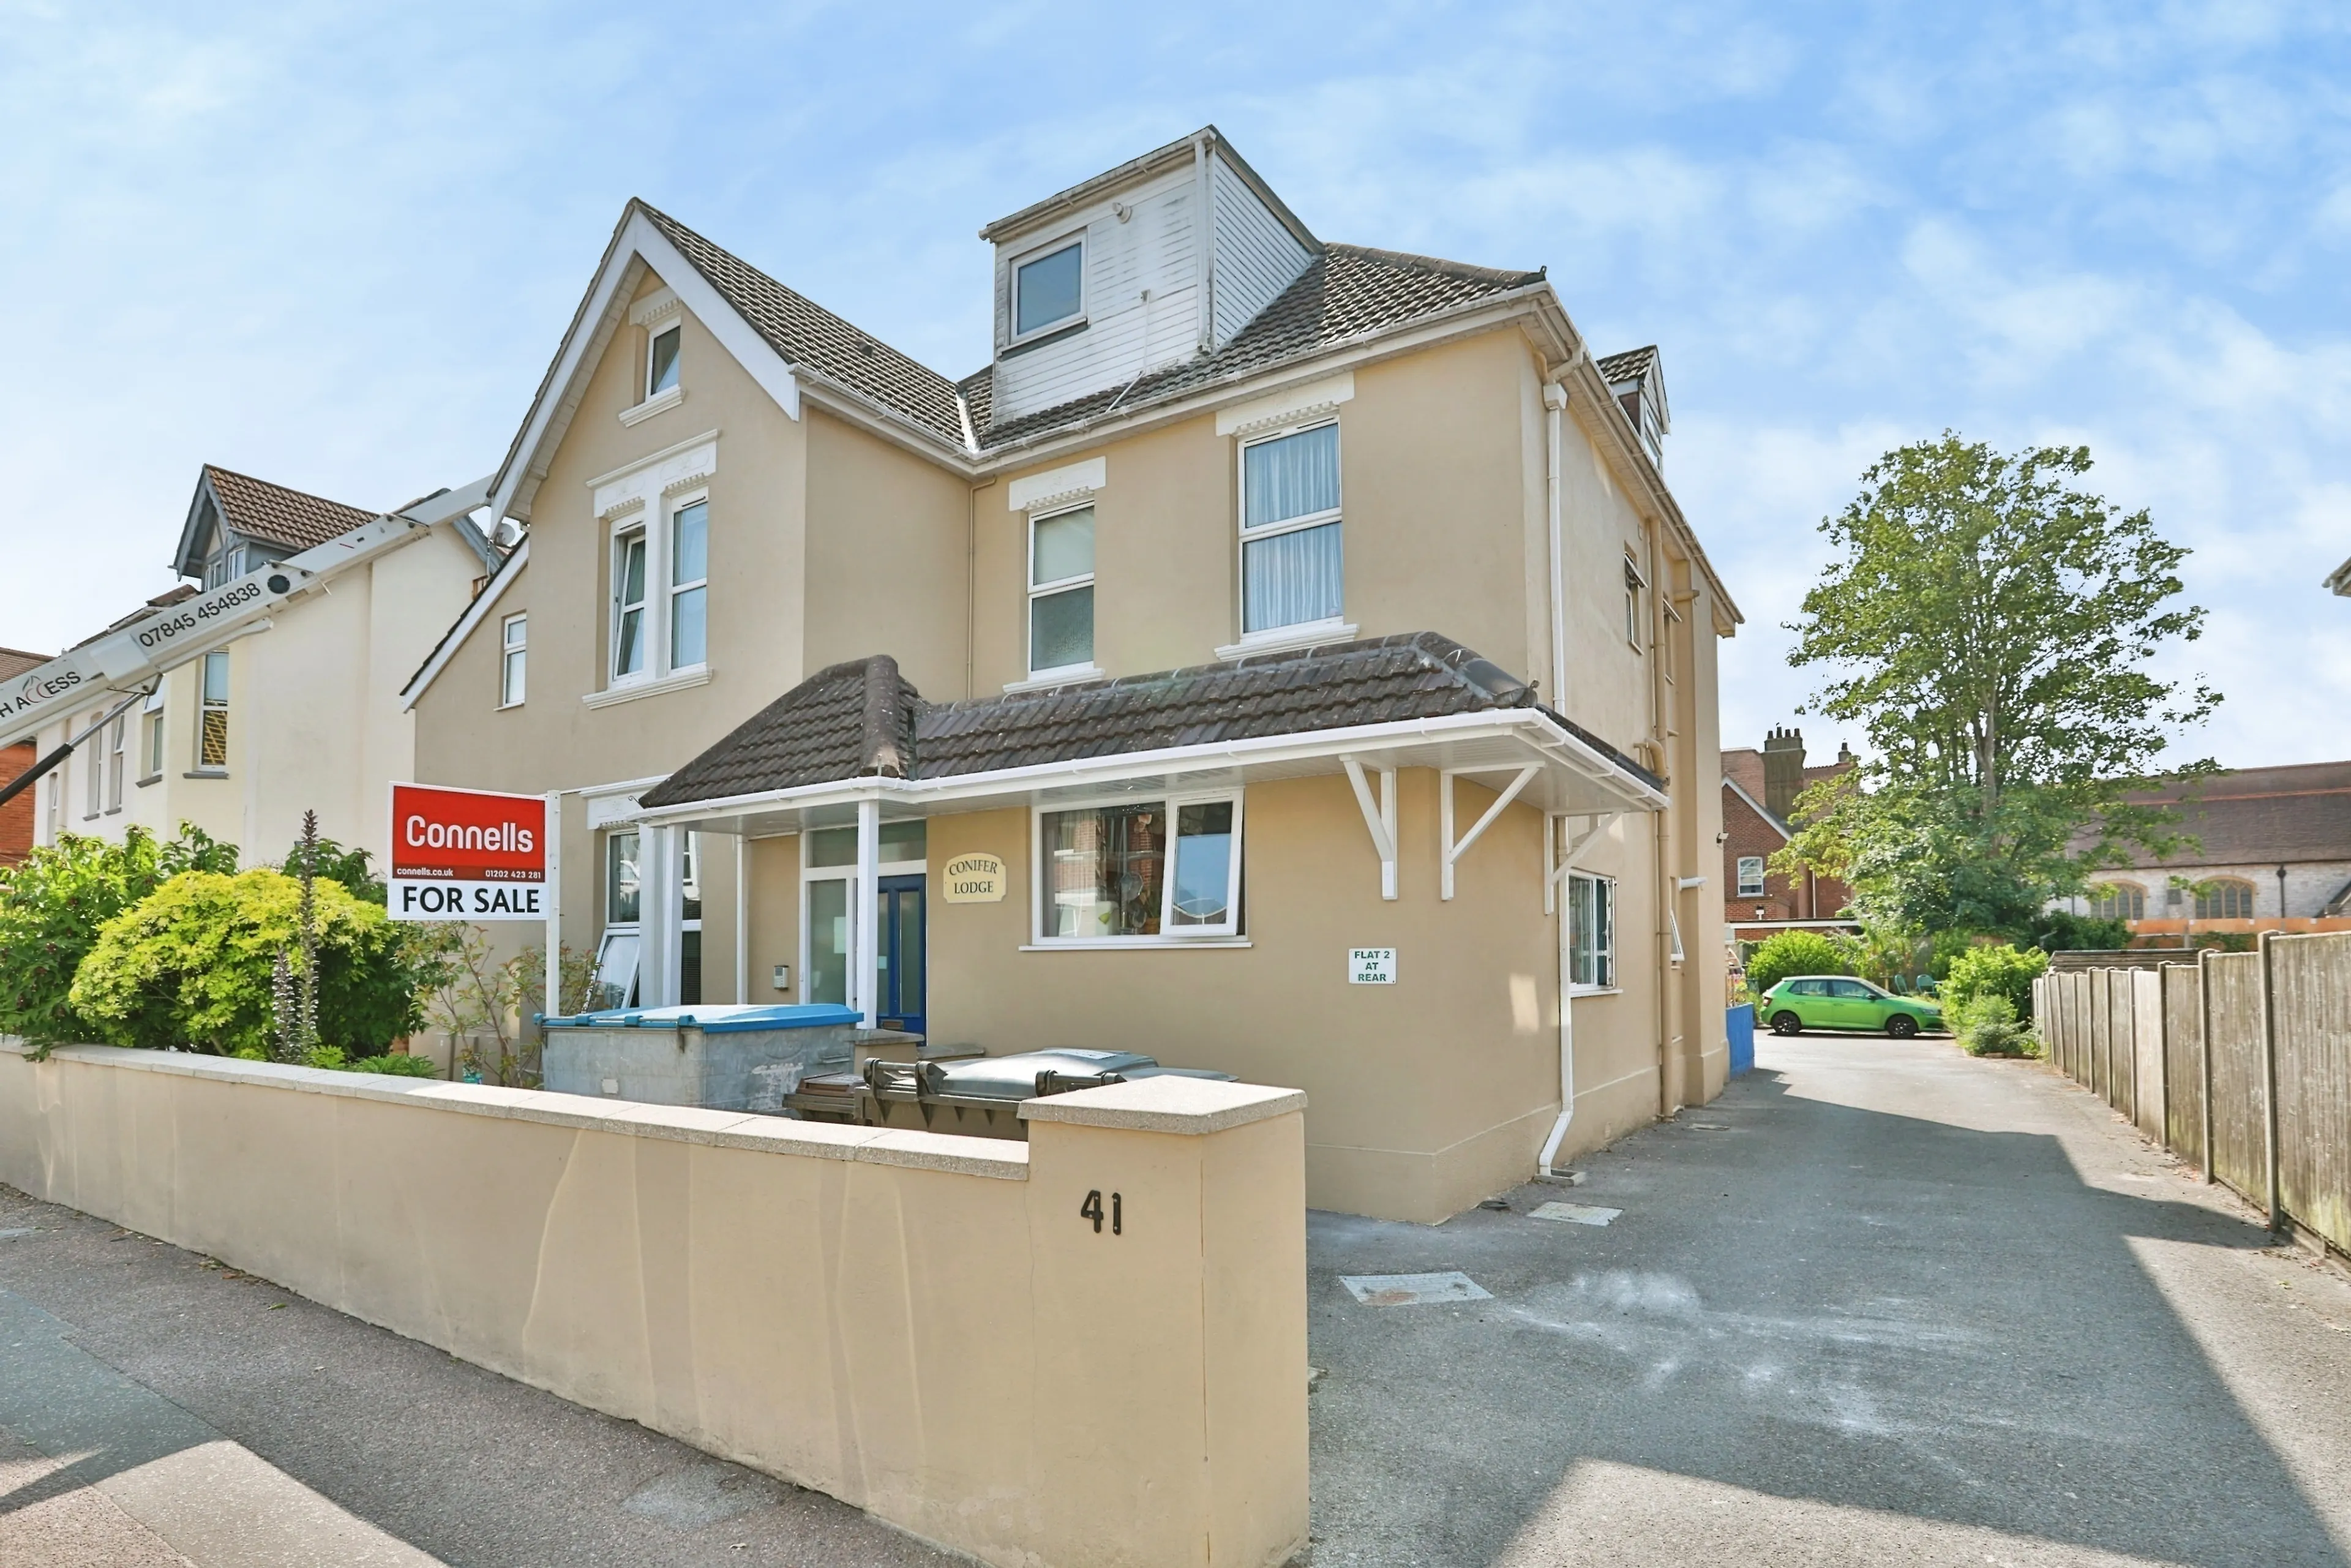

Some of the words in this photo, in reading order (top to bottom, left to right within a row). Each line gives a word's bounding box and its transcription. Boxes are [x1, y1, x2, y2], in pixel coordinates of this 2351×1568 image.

[139, 613, 196, 647] 07845
[198, 583, 261, 619] 454838
[15, 671, 81, 710] ACCESS
[407, 815, 533, 853] Connells
[397, 868, 453, 877] connells.co.uk
[486, 869, 508, 878] 01202
[949, 860, 997, 876] CONIFER
[954, 881, 994, 894] LODGE
[403, 886, 465, 913] FOR
[474, 888, 540, 913] SALE
[1365, 962, 1379, 970] AT
[1081, 1189, 1122, 1236] 41
